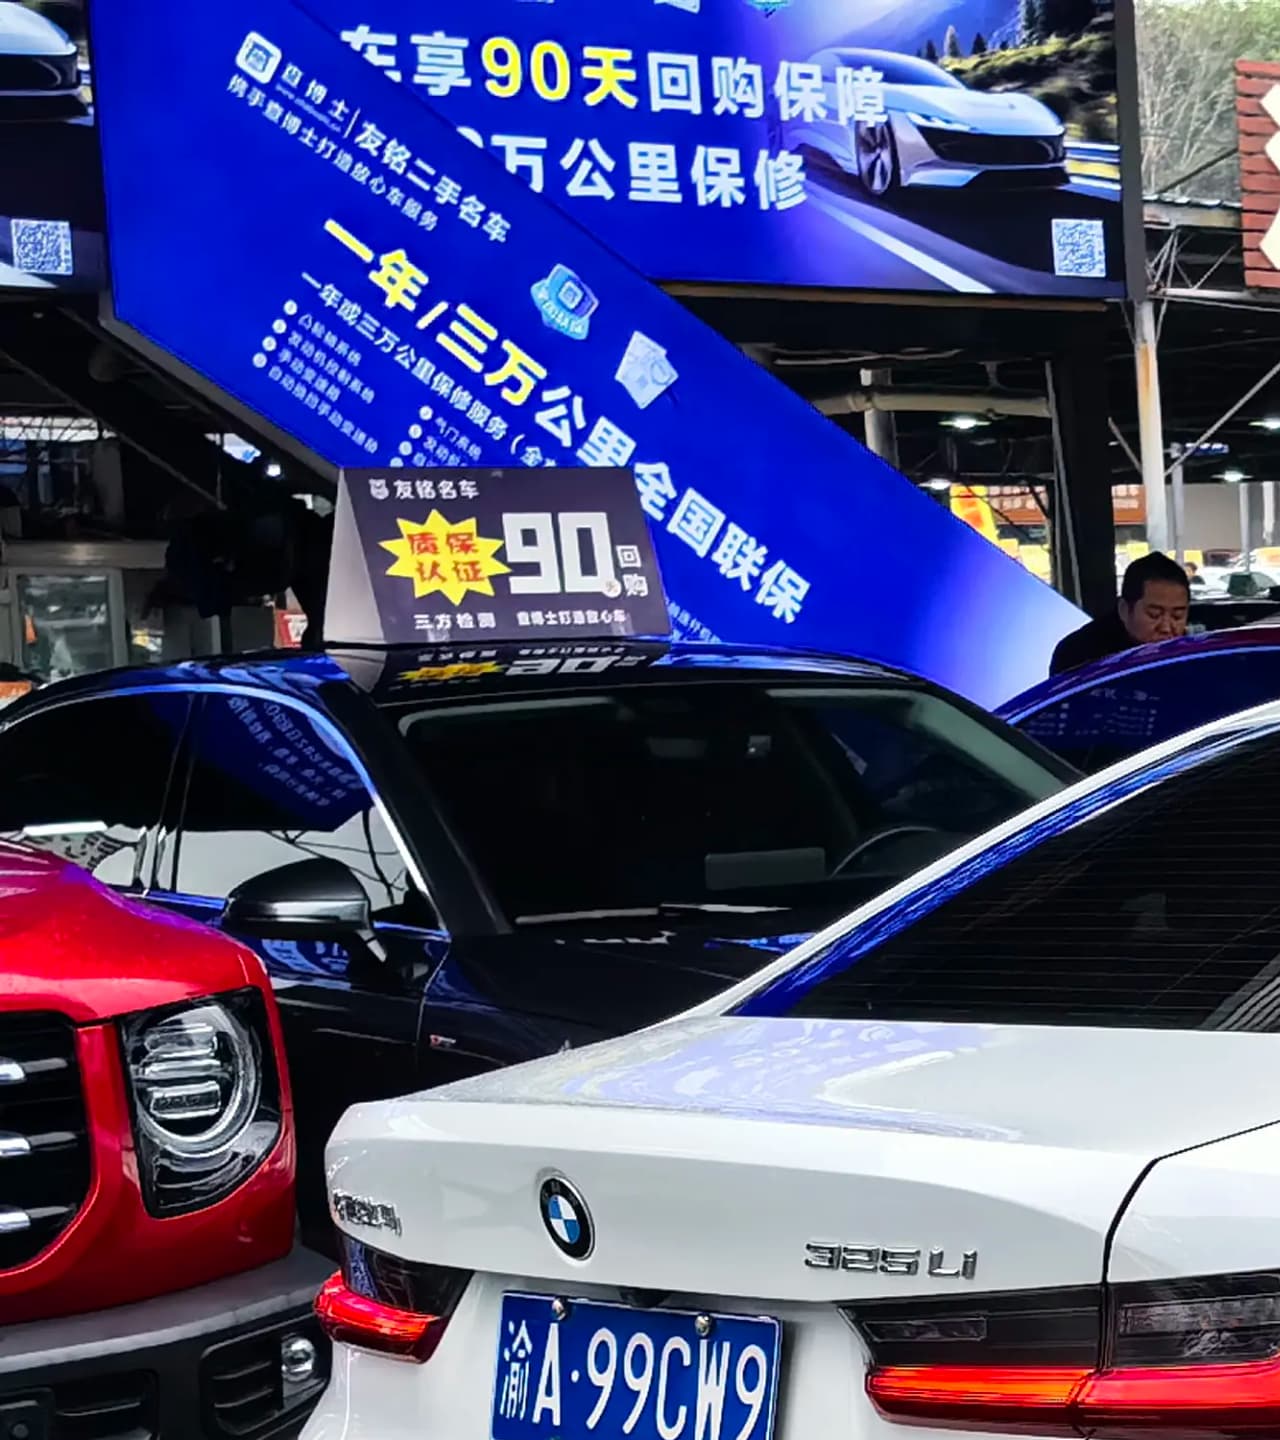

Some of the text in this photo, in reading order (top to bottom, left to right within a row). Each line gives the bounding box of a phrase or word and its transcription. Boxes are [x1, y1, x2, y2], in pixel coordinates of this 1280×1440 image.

[456, 124, 808, 211] 万公里保修
[393, 479, 480, 500] 友铭名车
[406, 531, 479, 555] 质保
[502, 512, 615, 594] 90
[415, 560, 486, 584] 认证
[615, 544, 648, 598] 回购
[414, 611, 497, 630] 三方检测
